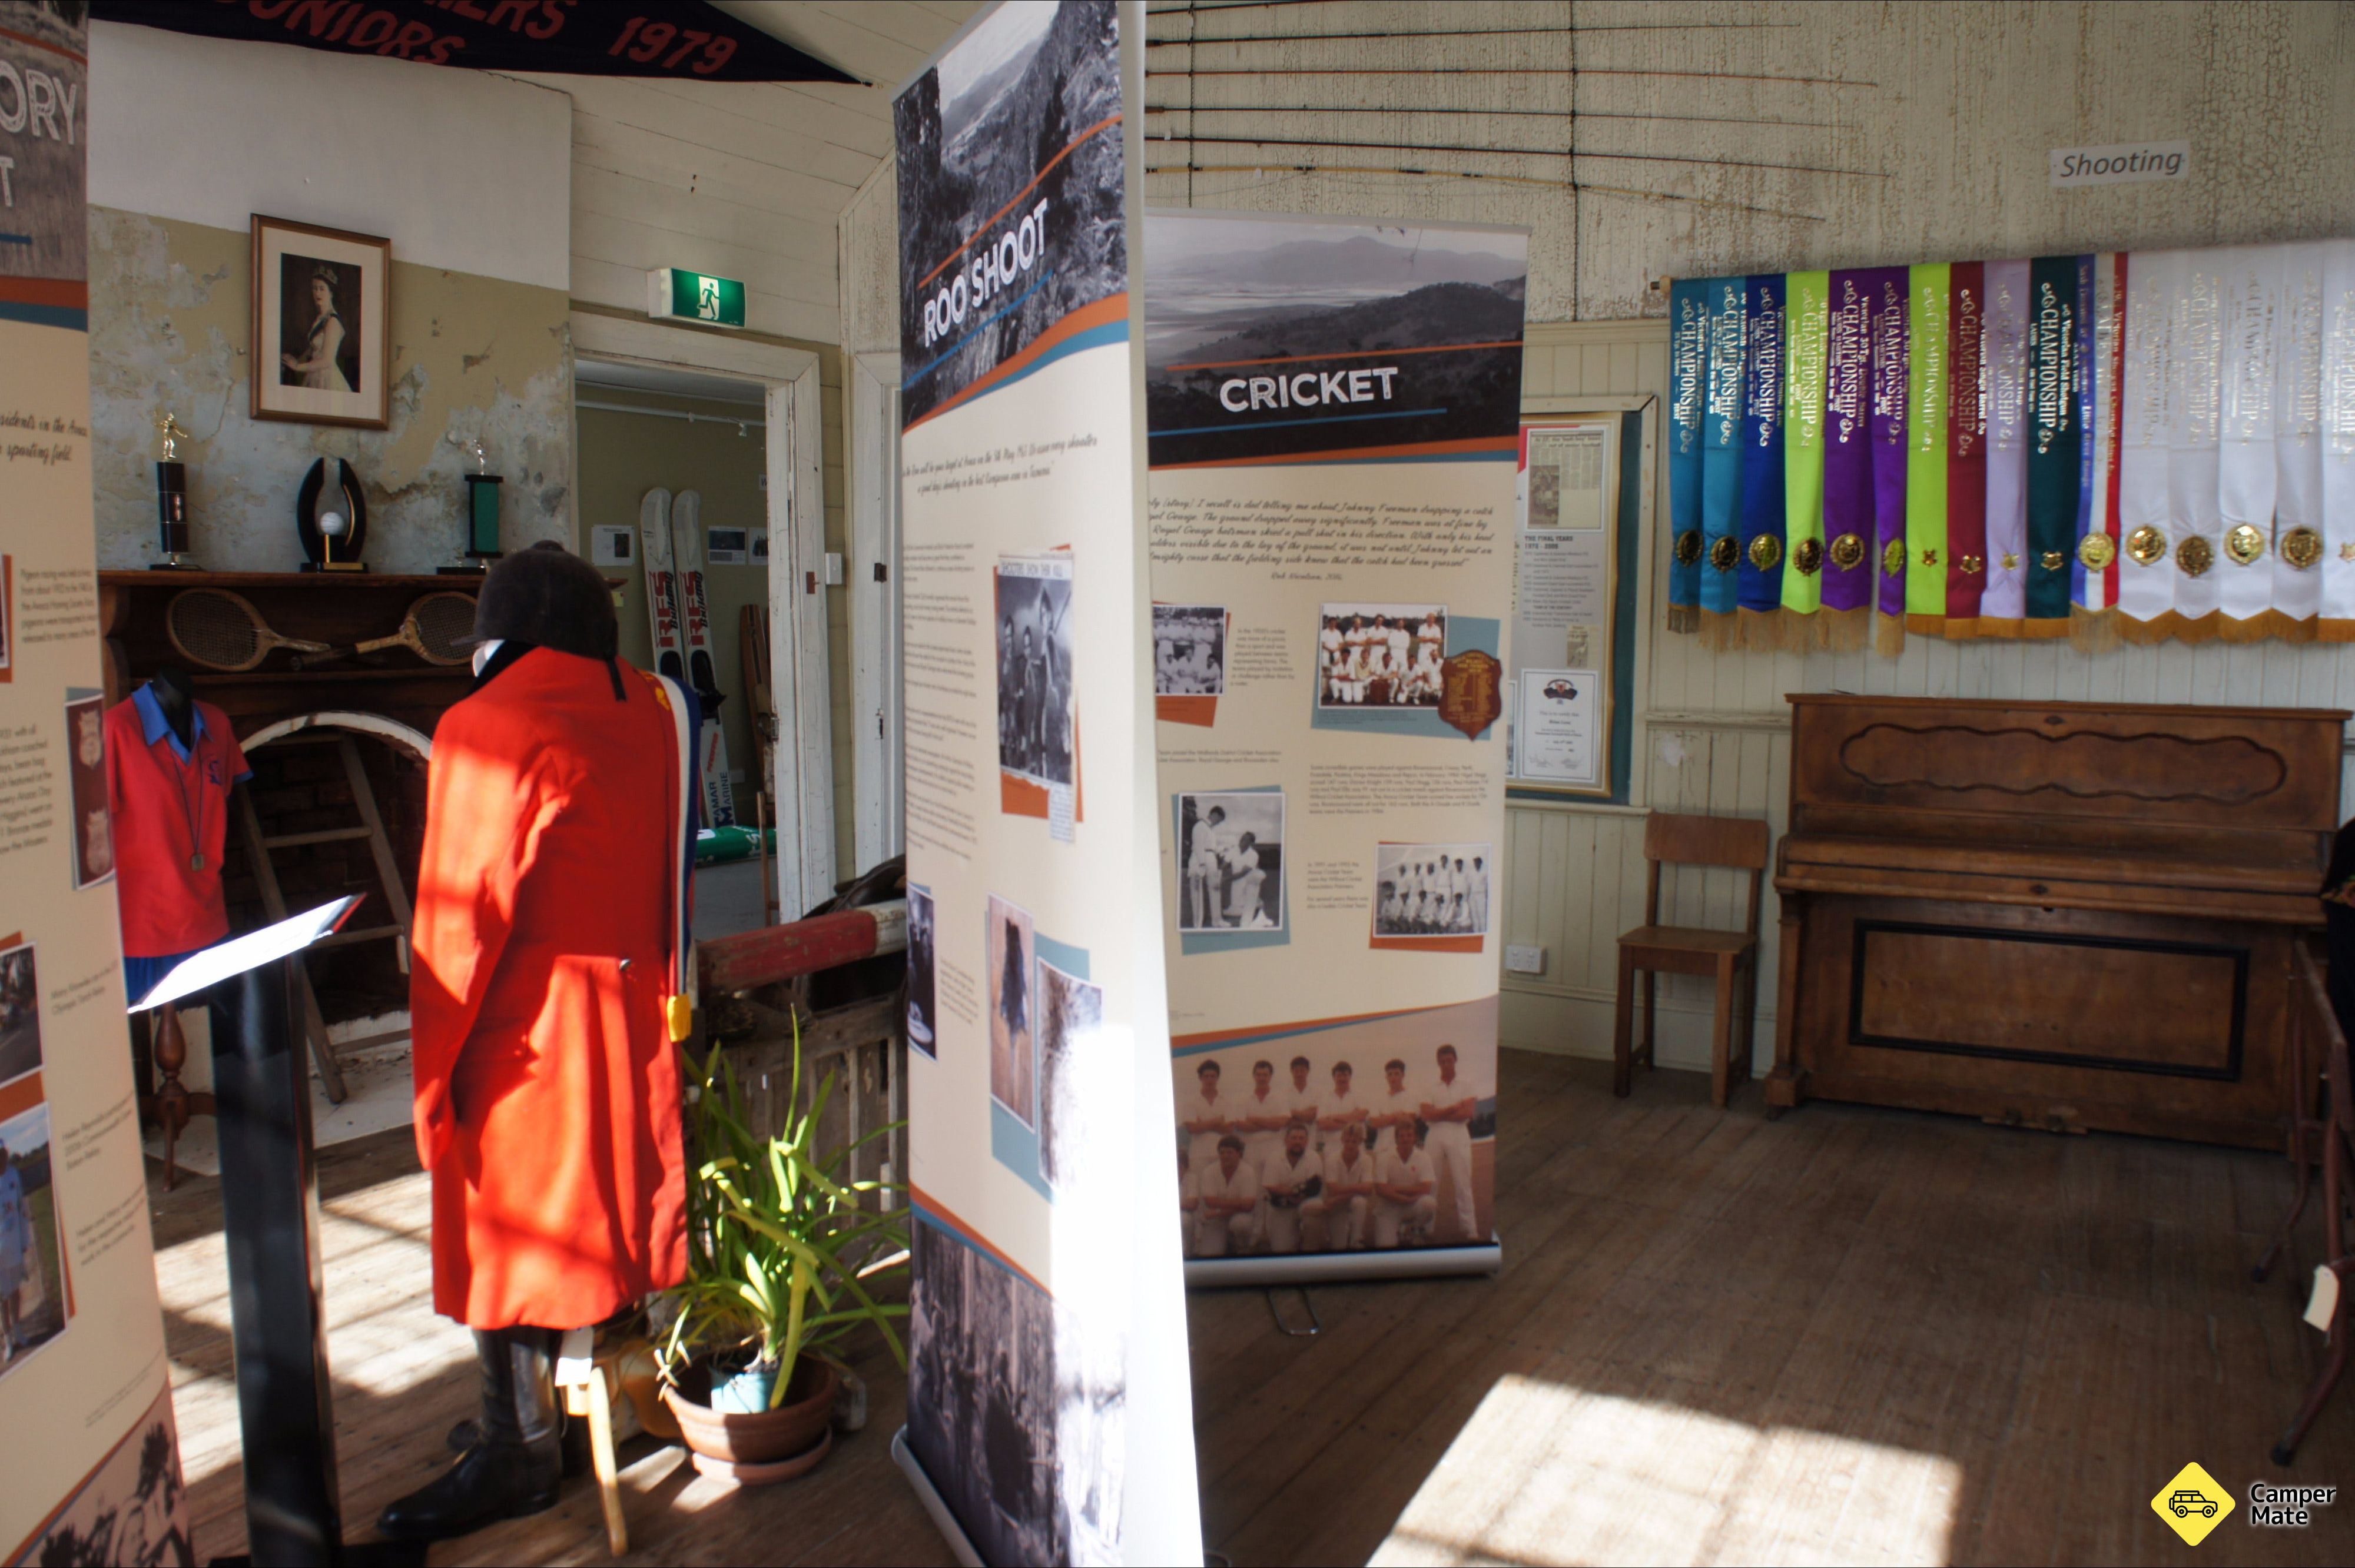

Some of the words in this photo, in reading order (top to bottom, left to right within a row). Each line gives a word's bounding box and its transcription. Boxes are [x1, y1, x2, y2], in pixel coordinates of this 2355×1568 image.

[213, 0, 466, 64] UNIORS
[424, 0, 578, 39] ERS
[608, 16, 738, 75] 1979
[2060, 150, 2182, 177] Shooting
[924, 275, 966, 348] ROO
[971, 197, 1047, 308] SHOOT
[1860, 297, 1869, 334] Victorian
[2113, 312, 2122, 352] Victorian
[2061, 320, 2072, 357] Victorian
[2189, 298, 2208, 418] CHAMPIONSHIP
[1680, 322, 1696, 430] CHAMPIONSHIP
[1720, 311, 1738, 420] CHAMPIONSHIP
[1759, 311, 1776, 421] CHAMPIONSHIP
[1801, 313, 1817, 424] CHAMPIONSHIP
[1840, 305, 1859, 418] CHAMPIONSHIP
[1884, 306, 1902, 420] CHAMPIONSHIP
[1922, 313, 1940, 428] CHAMPIONSHIP
[1958, 315, 1977, 431] CHAMPIONSHIP
[2039, 309, 2059, 427] CHAMPIONSHIP
[2059, 360, 2069, 380] Field
[1219, 367, 1398, 412] CRICKET
[2058, 382, 2069, 416] Shotgun
[0, 411, 35, 430] sidents
[2082, 406, 2092, 429] Little
[7, 442, 49, 465] sporting
[1219, 514, 1254, 524] ground
[1420, 504, 1462, 516] dropping
[1153, 525, 1182, 536] Royal
[1184, 526, 1213, 537] George
[1435, 532, 1456, 543] only
[1474, 533, 1495, 541] head
[1180, 539, 1209, 547] visible
[1242, 540, 1255, 549] the
[1211, 553, 1232, 562] that
[1409, 557, 1428, 566] been
[719, 772, 734, 826] MARINE
